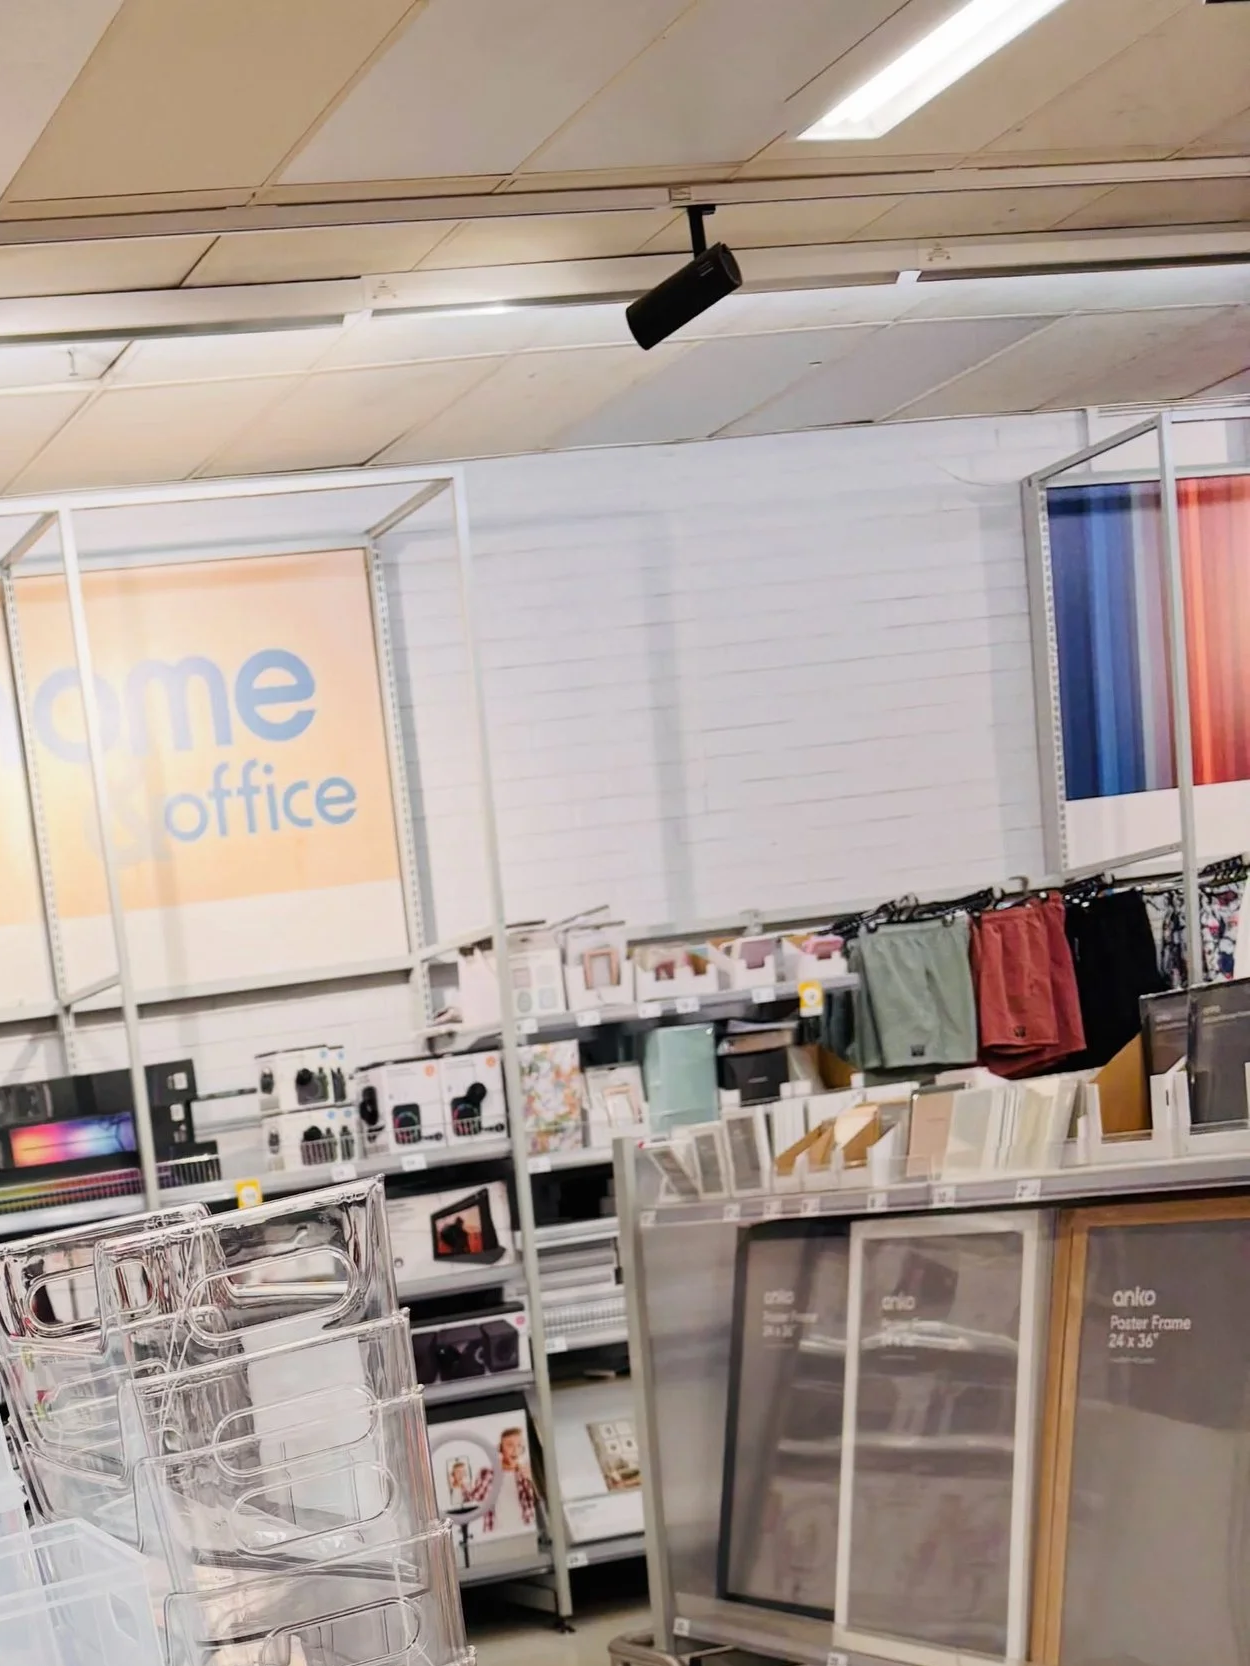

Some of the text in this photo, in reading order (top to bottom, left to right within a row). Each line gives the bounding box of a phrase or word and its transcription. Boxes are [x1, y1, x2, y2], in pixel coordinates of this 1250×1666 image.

[163, 759, 357, 842] office
[1112, 1286, 1156, 1307] anko
[1110, 1314, 1192, 1331] Poster Frame
[1108, 1332, 1124, 1348] 24
[1126, 1336, 1135, 1348] x
